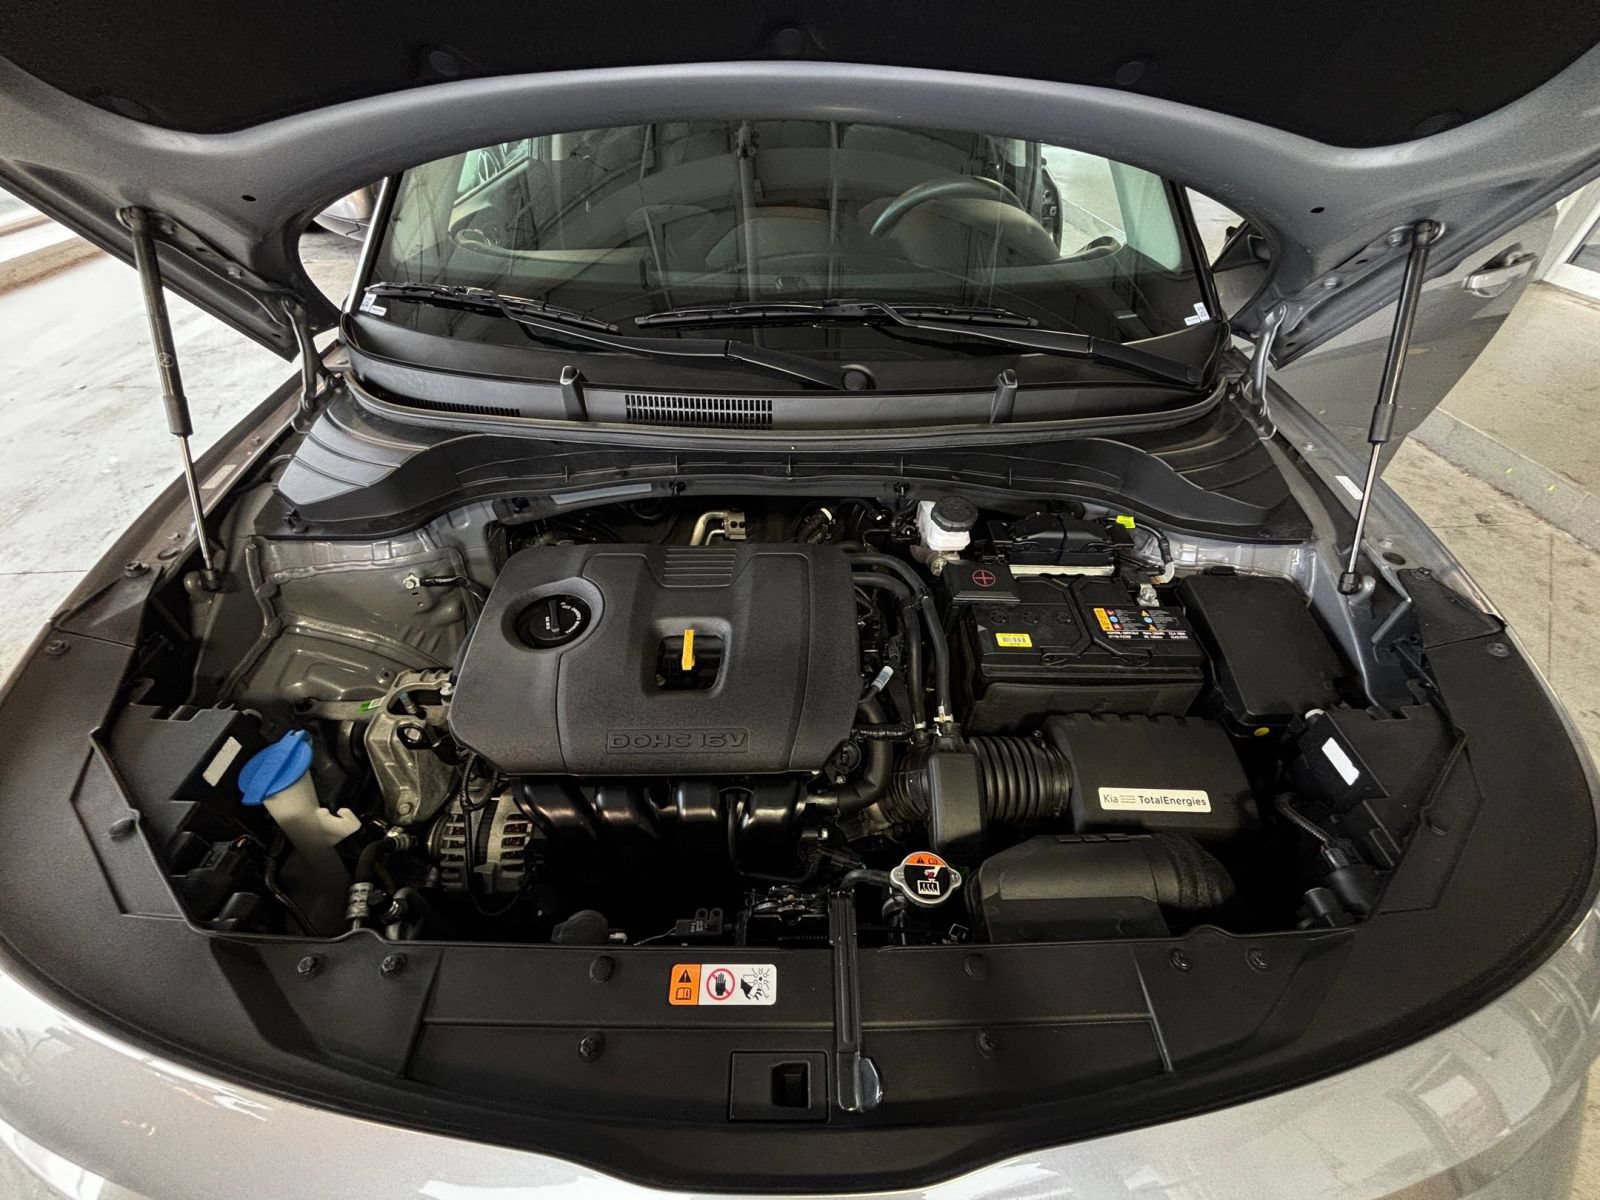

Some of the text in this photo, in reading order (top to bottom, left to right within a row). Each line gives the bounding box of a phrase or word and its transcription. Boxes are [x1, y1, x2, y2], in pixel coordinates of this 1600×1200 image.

[608, 732, 748, 749] DOHC 16V
[1103, 794, 1207, 807] Kia TotalEnergies
